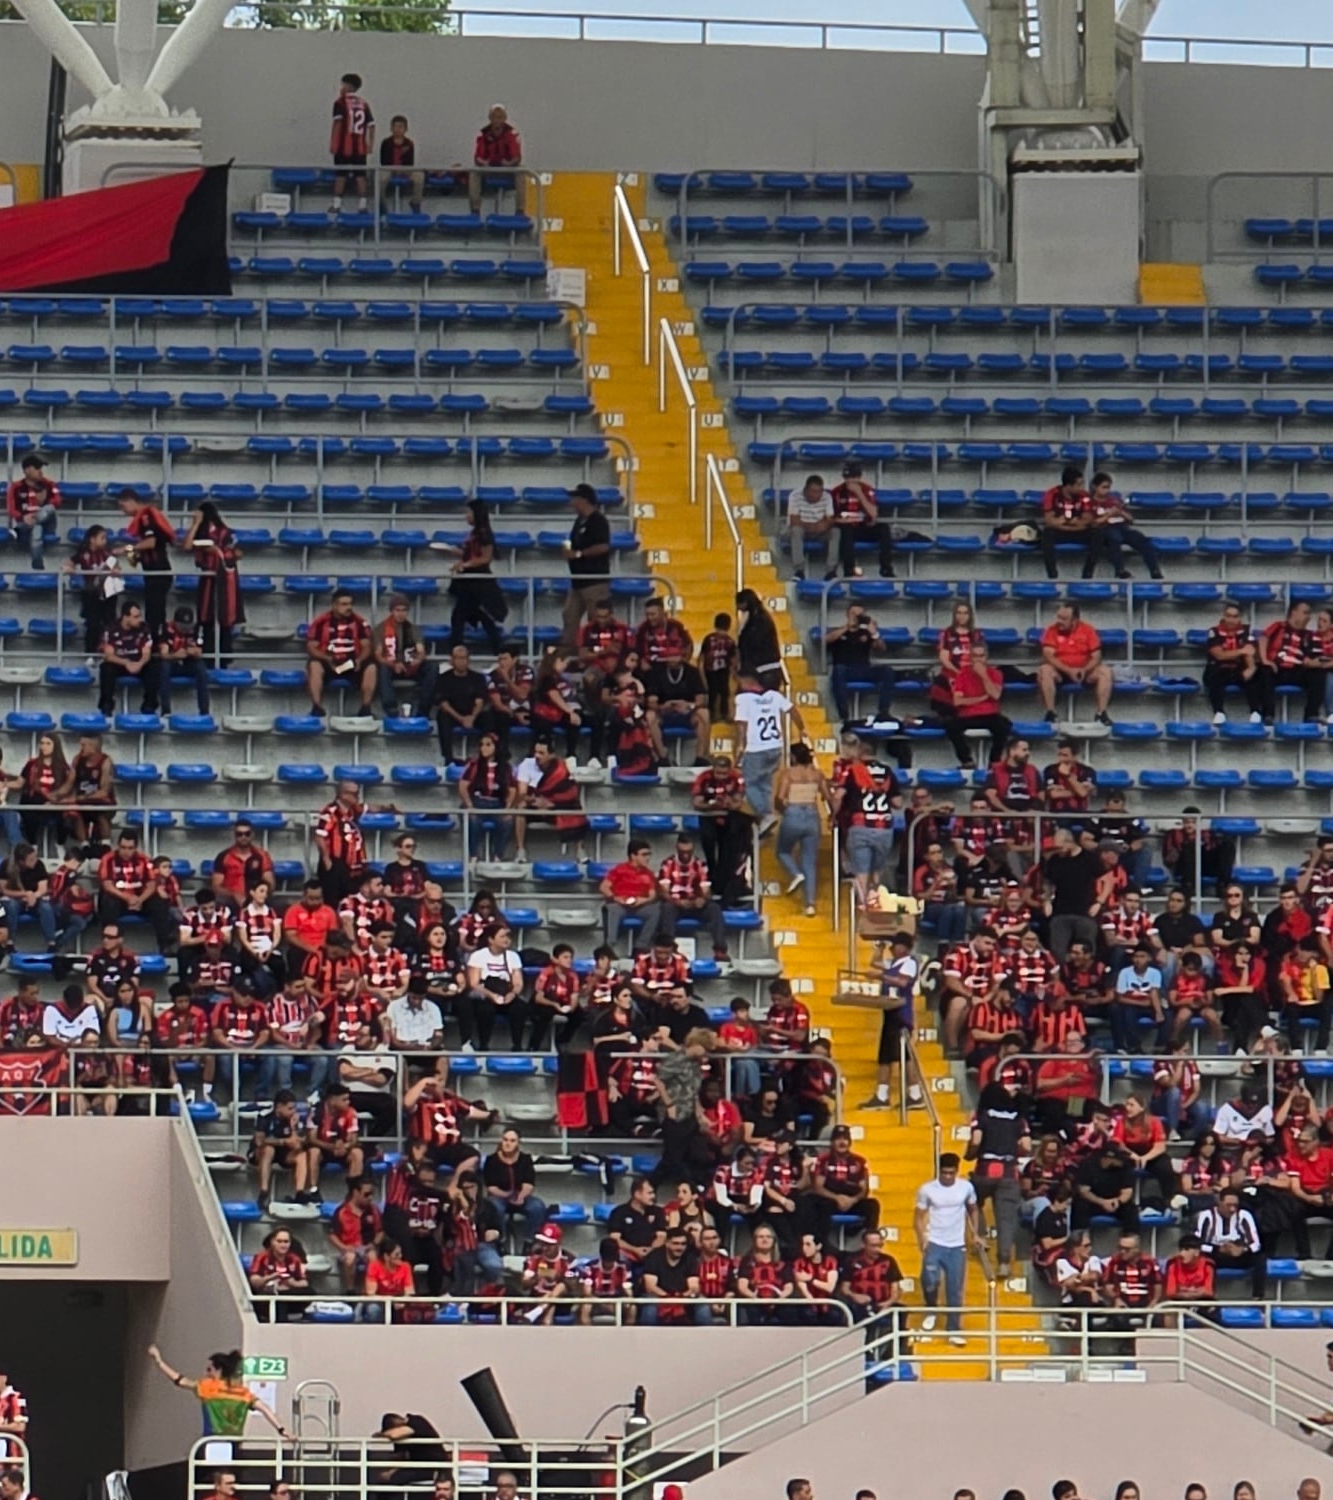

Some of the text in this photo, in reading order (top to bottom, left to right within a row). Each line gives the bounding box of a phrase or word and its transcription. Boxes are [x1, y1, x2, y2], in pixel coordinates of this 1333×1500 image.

[348, 110, 366, 134] 12
[592, 366, 602, 377] V
[605, 414, 616, 425] U
[704, 414, 714, 426] U
[757, 716, 781, 741] 23
[259, 1358, 286, 1374] E23
